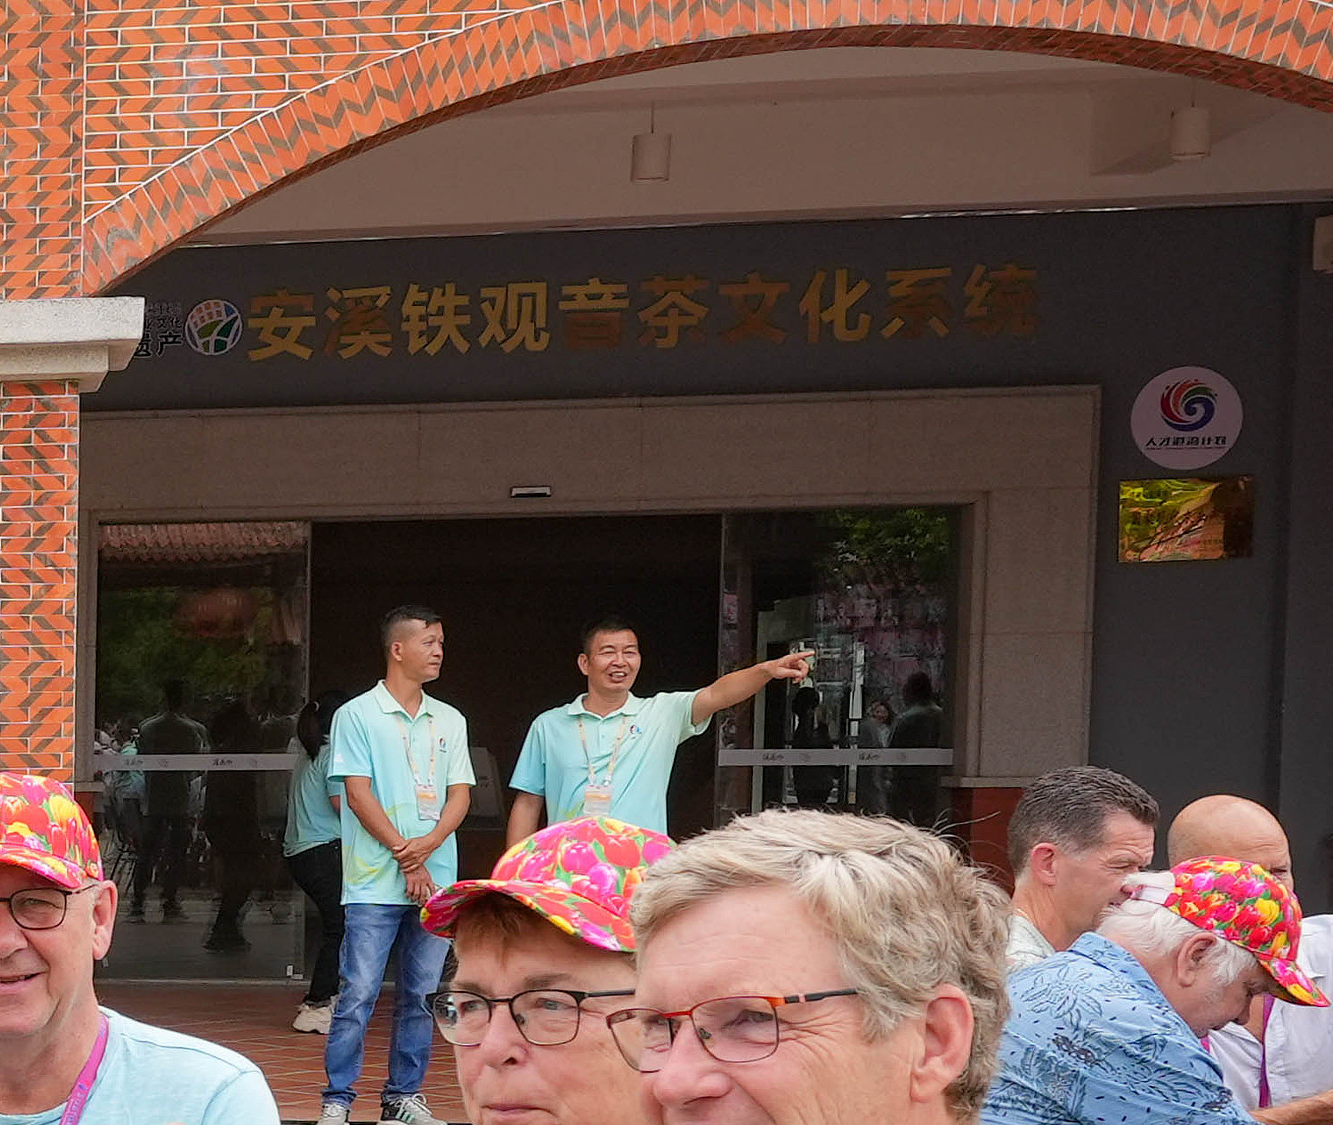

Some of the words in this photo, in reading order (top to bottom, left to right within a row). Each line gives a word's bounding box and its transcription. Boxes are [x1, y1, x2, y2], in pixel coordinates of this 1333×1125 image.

[247, 263, 1037, 361] 安溪铁观音茶文化系统
